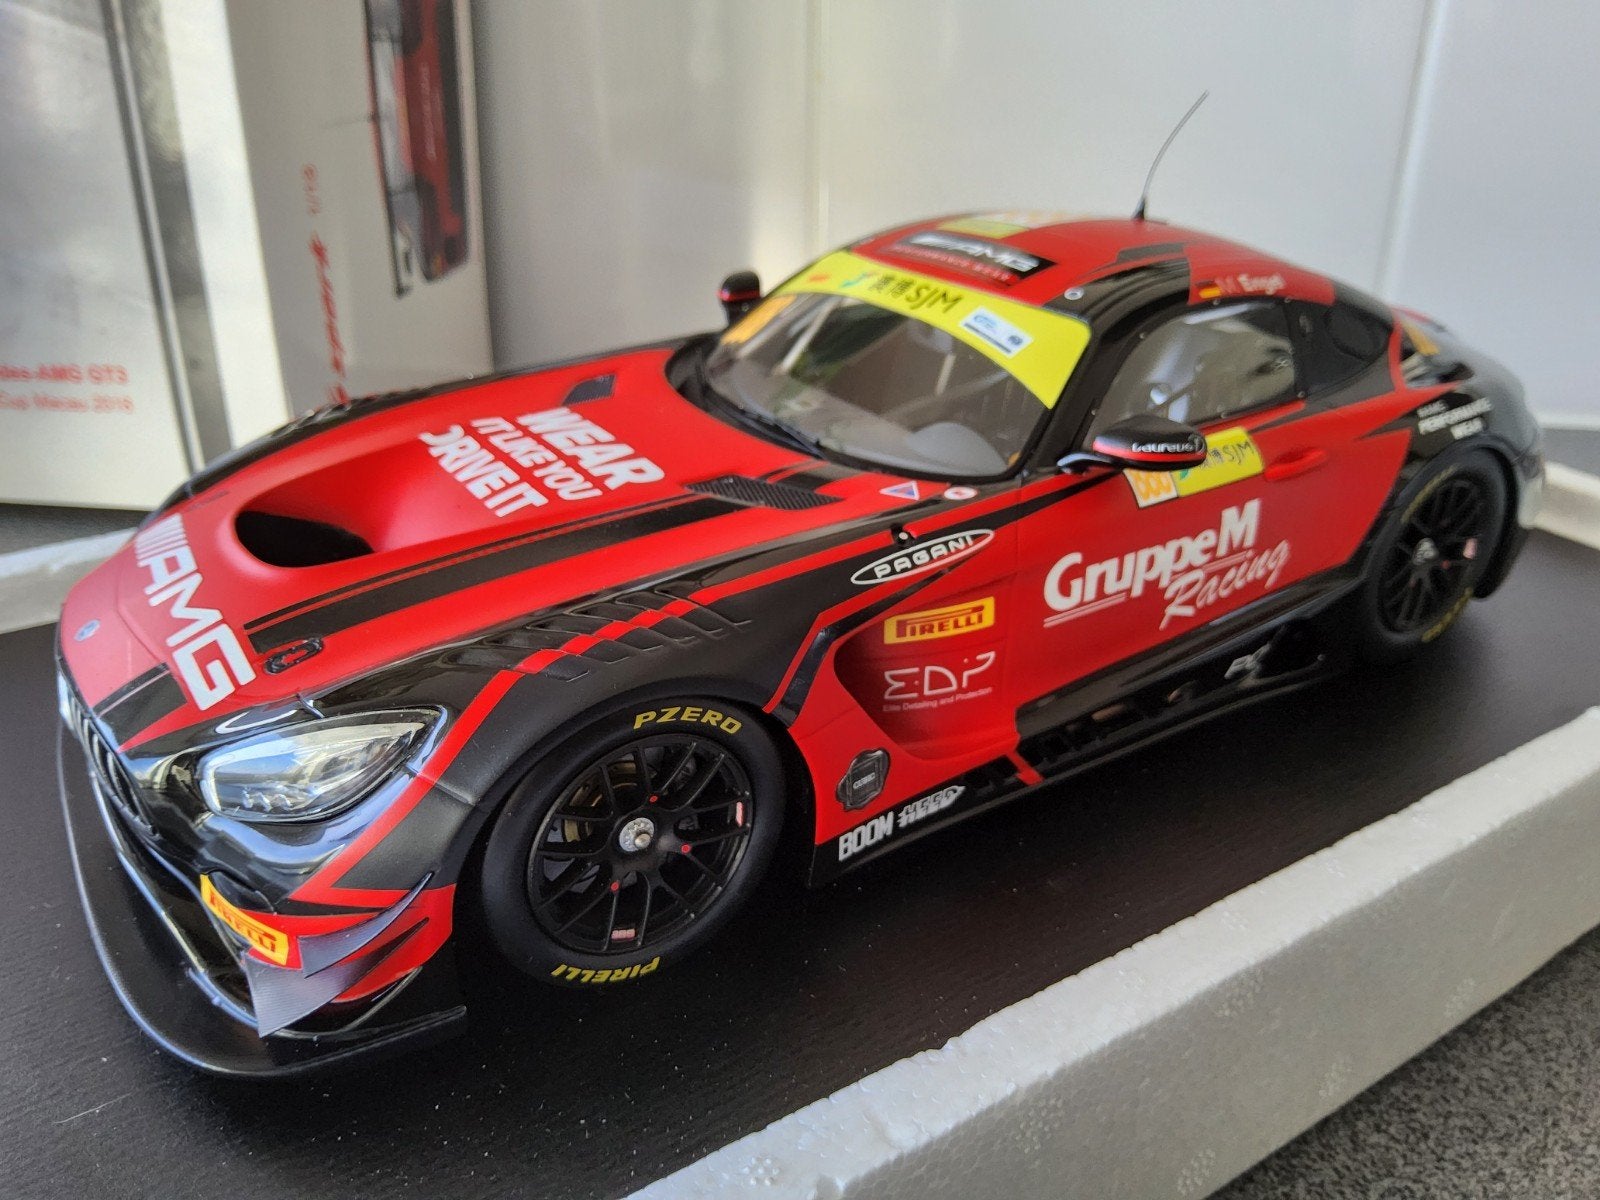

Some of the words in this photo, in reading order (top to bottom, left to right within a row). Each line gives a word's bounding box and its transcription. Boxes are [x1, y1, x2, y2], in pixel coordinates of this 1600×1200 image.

[488, 429, 559, 468] LIKE
[533, 460, 603, 501] YOU
[516, 407, 665, 490] WEAR
[484, 481, 550, 517] IT
[874, 535, 974, 579] PAGANI
[1043, 498, 1261, 612] GruppeM
[1158, 540, 1290, 631] Racing
[895, 604, 985, 639] PIRELLI
[838, 811, 894, 861] BOOM
[209, 889, 278, 953] PIRELLI
[550, 955, 661, 984] PIRELLI
